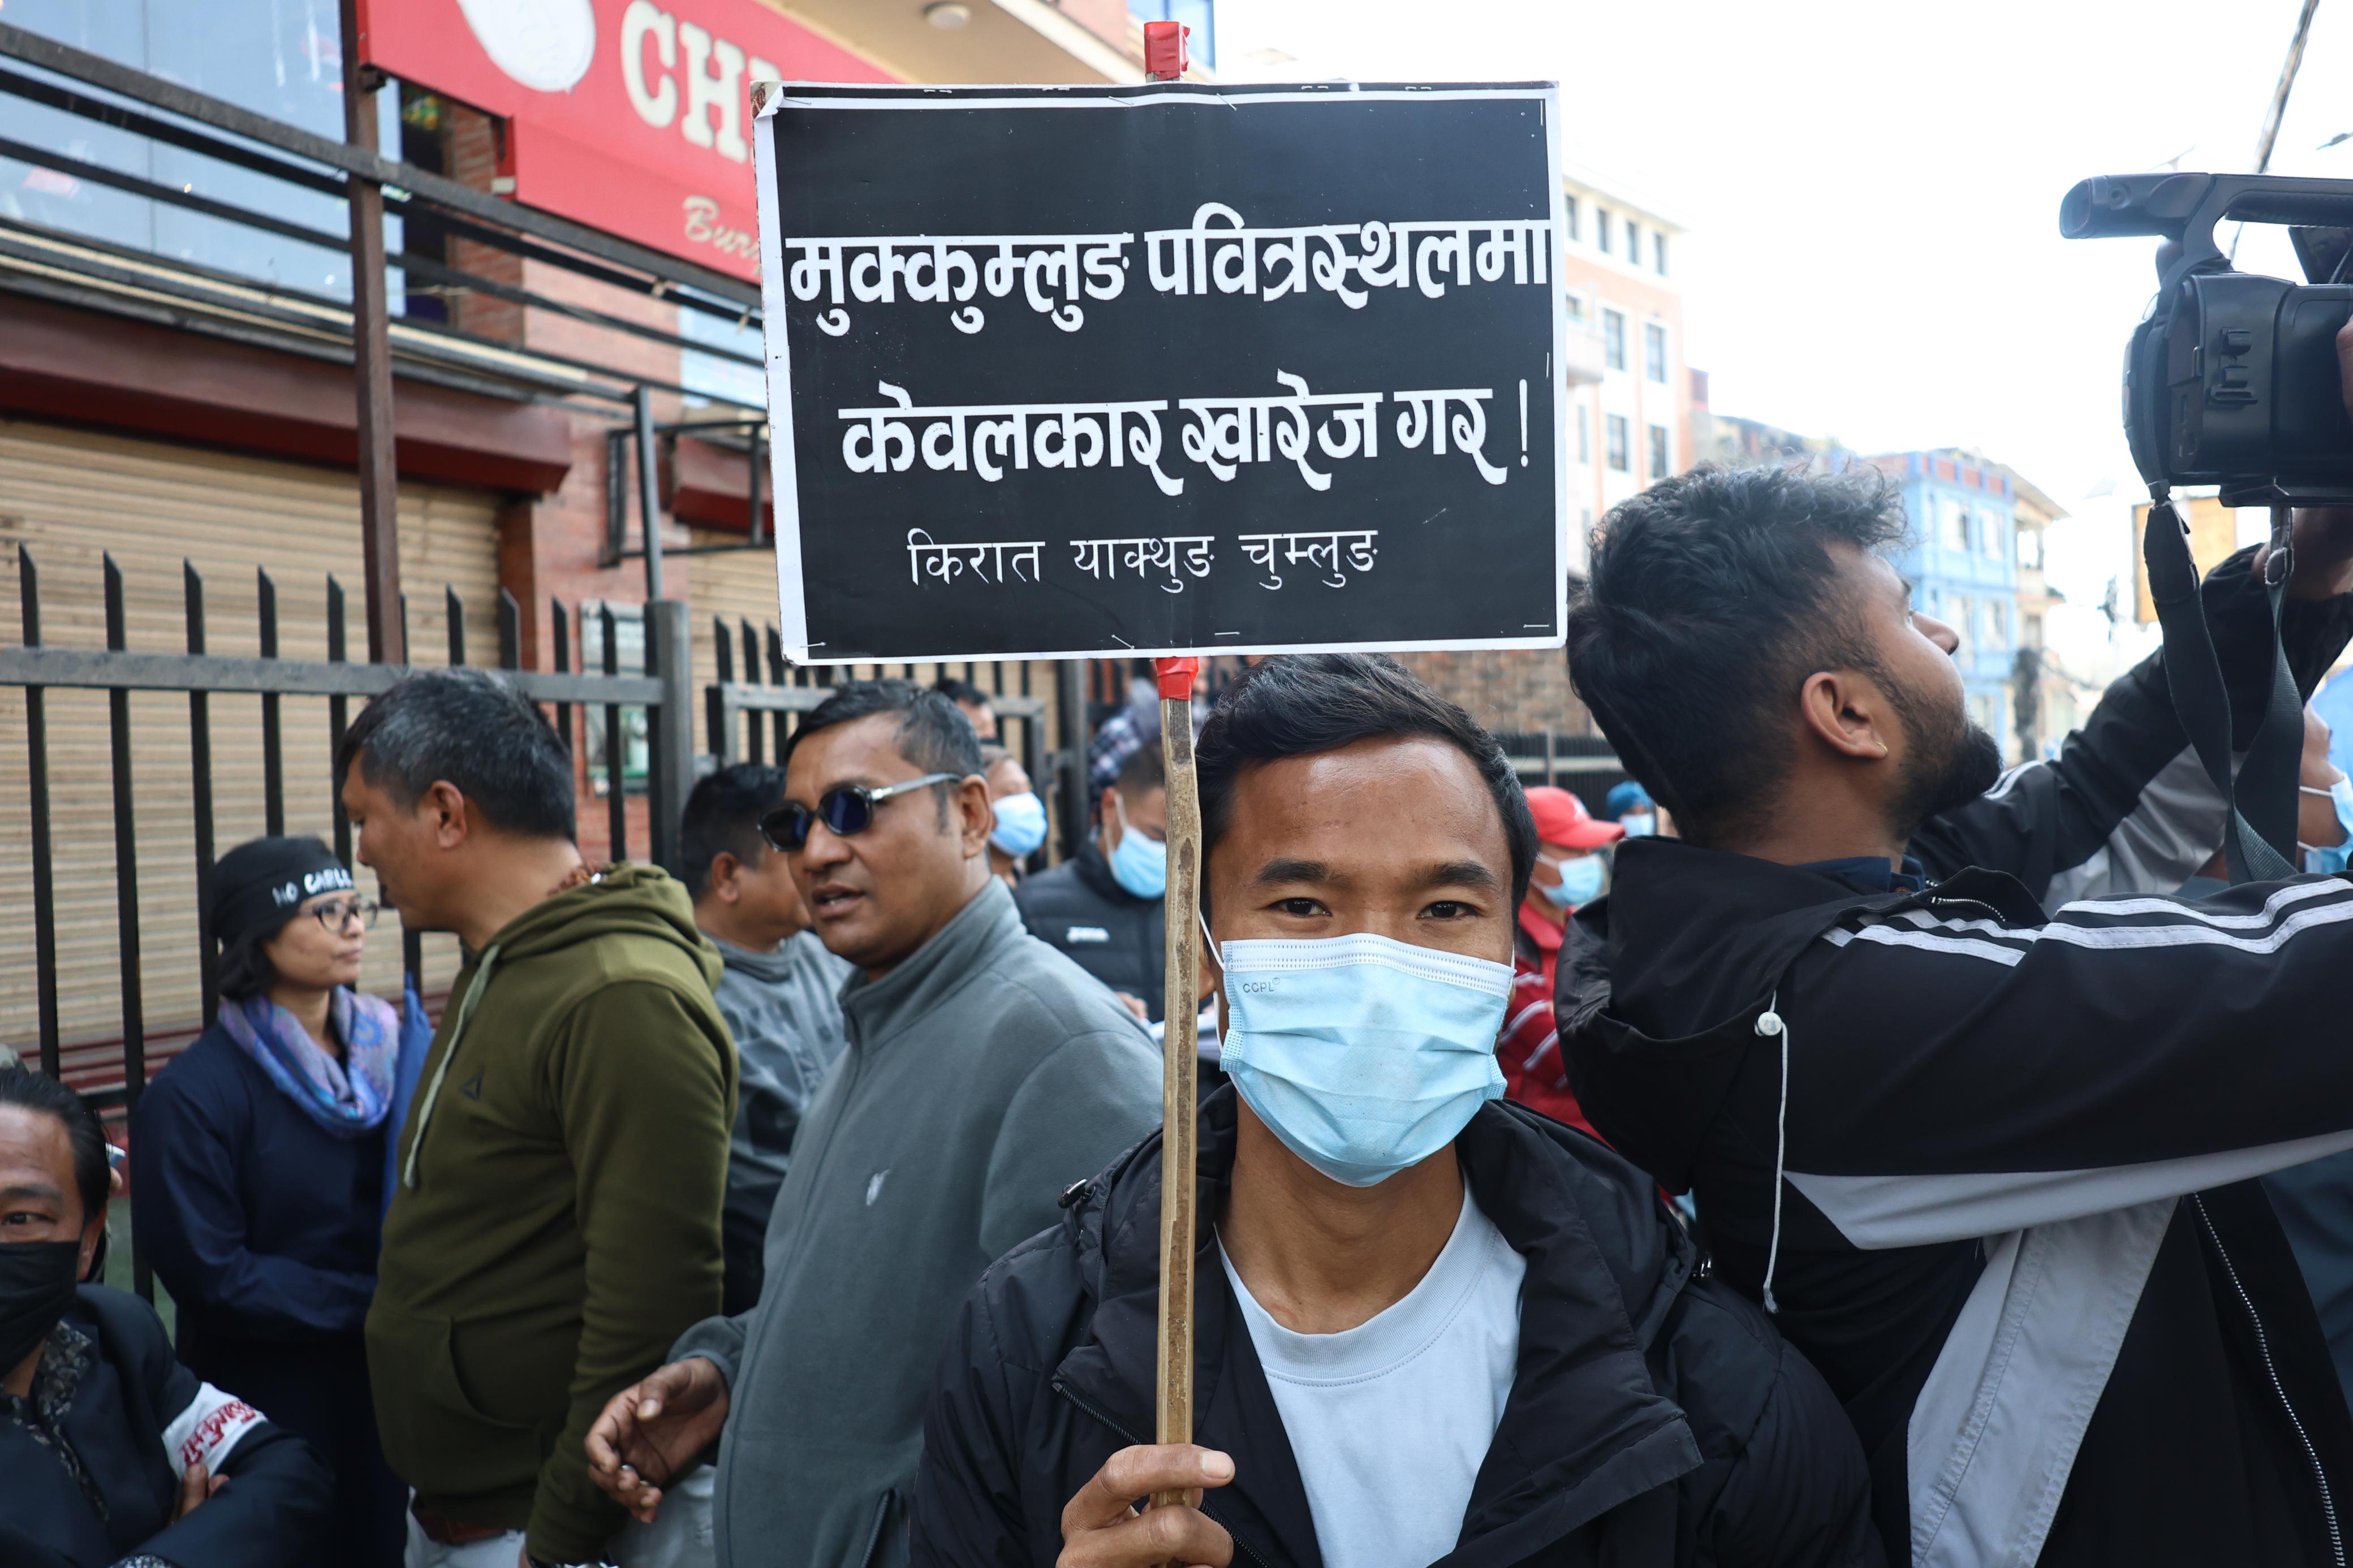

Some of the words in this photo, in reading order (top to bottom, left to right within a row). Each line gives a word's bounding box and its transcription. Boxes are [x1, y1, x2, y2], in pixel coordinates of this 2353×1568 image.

[620, 0, 781, 163] CH
[682, 195, 761, 278] Bur
[1144, 201, 1550, 310] पवित्रस्थलमा
[838, 380, 1184, 496] केवलकार
[1178, 368, 1384, 491] खारेज
[907, 528, 1046, 585] किरात
[1070, 536, 1215, 594] याक्थुङ
[1238, 530, 1378, 590] चुम्लुङ
